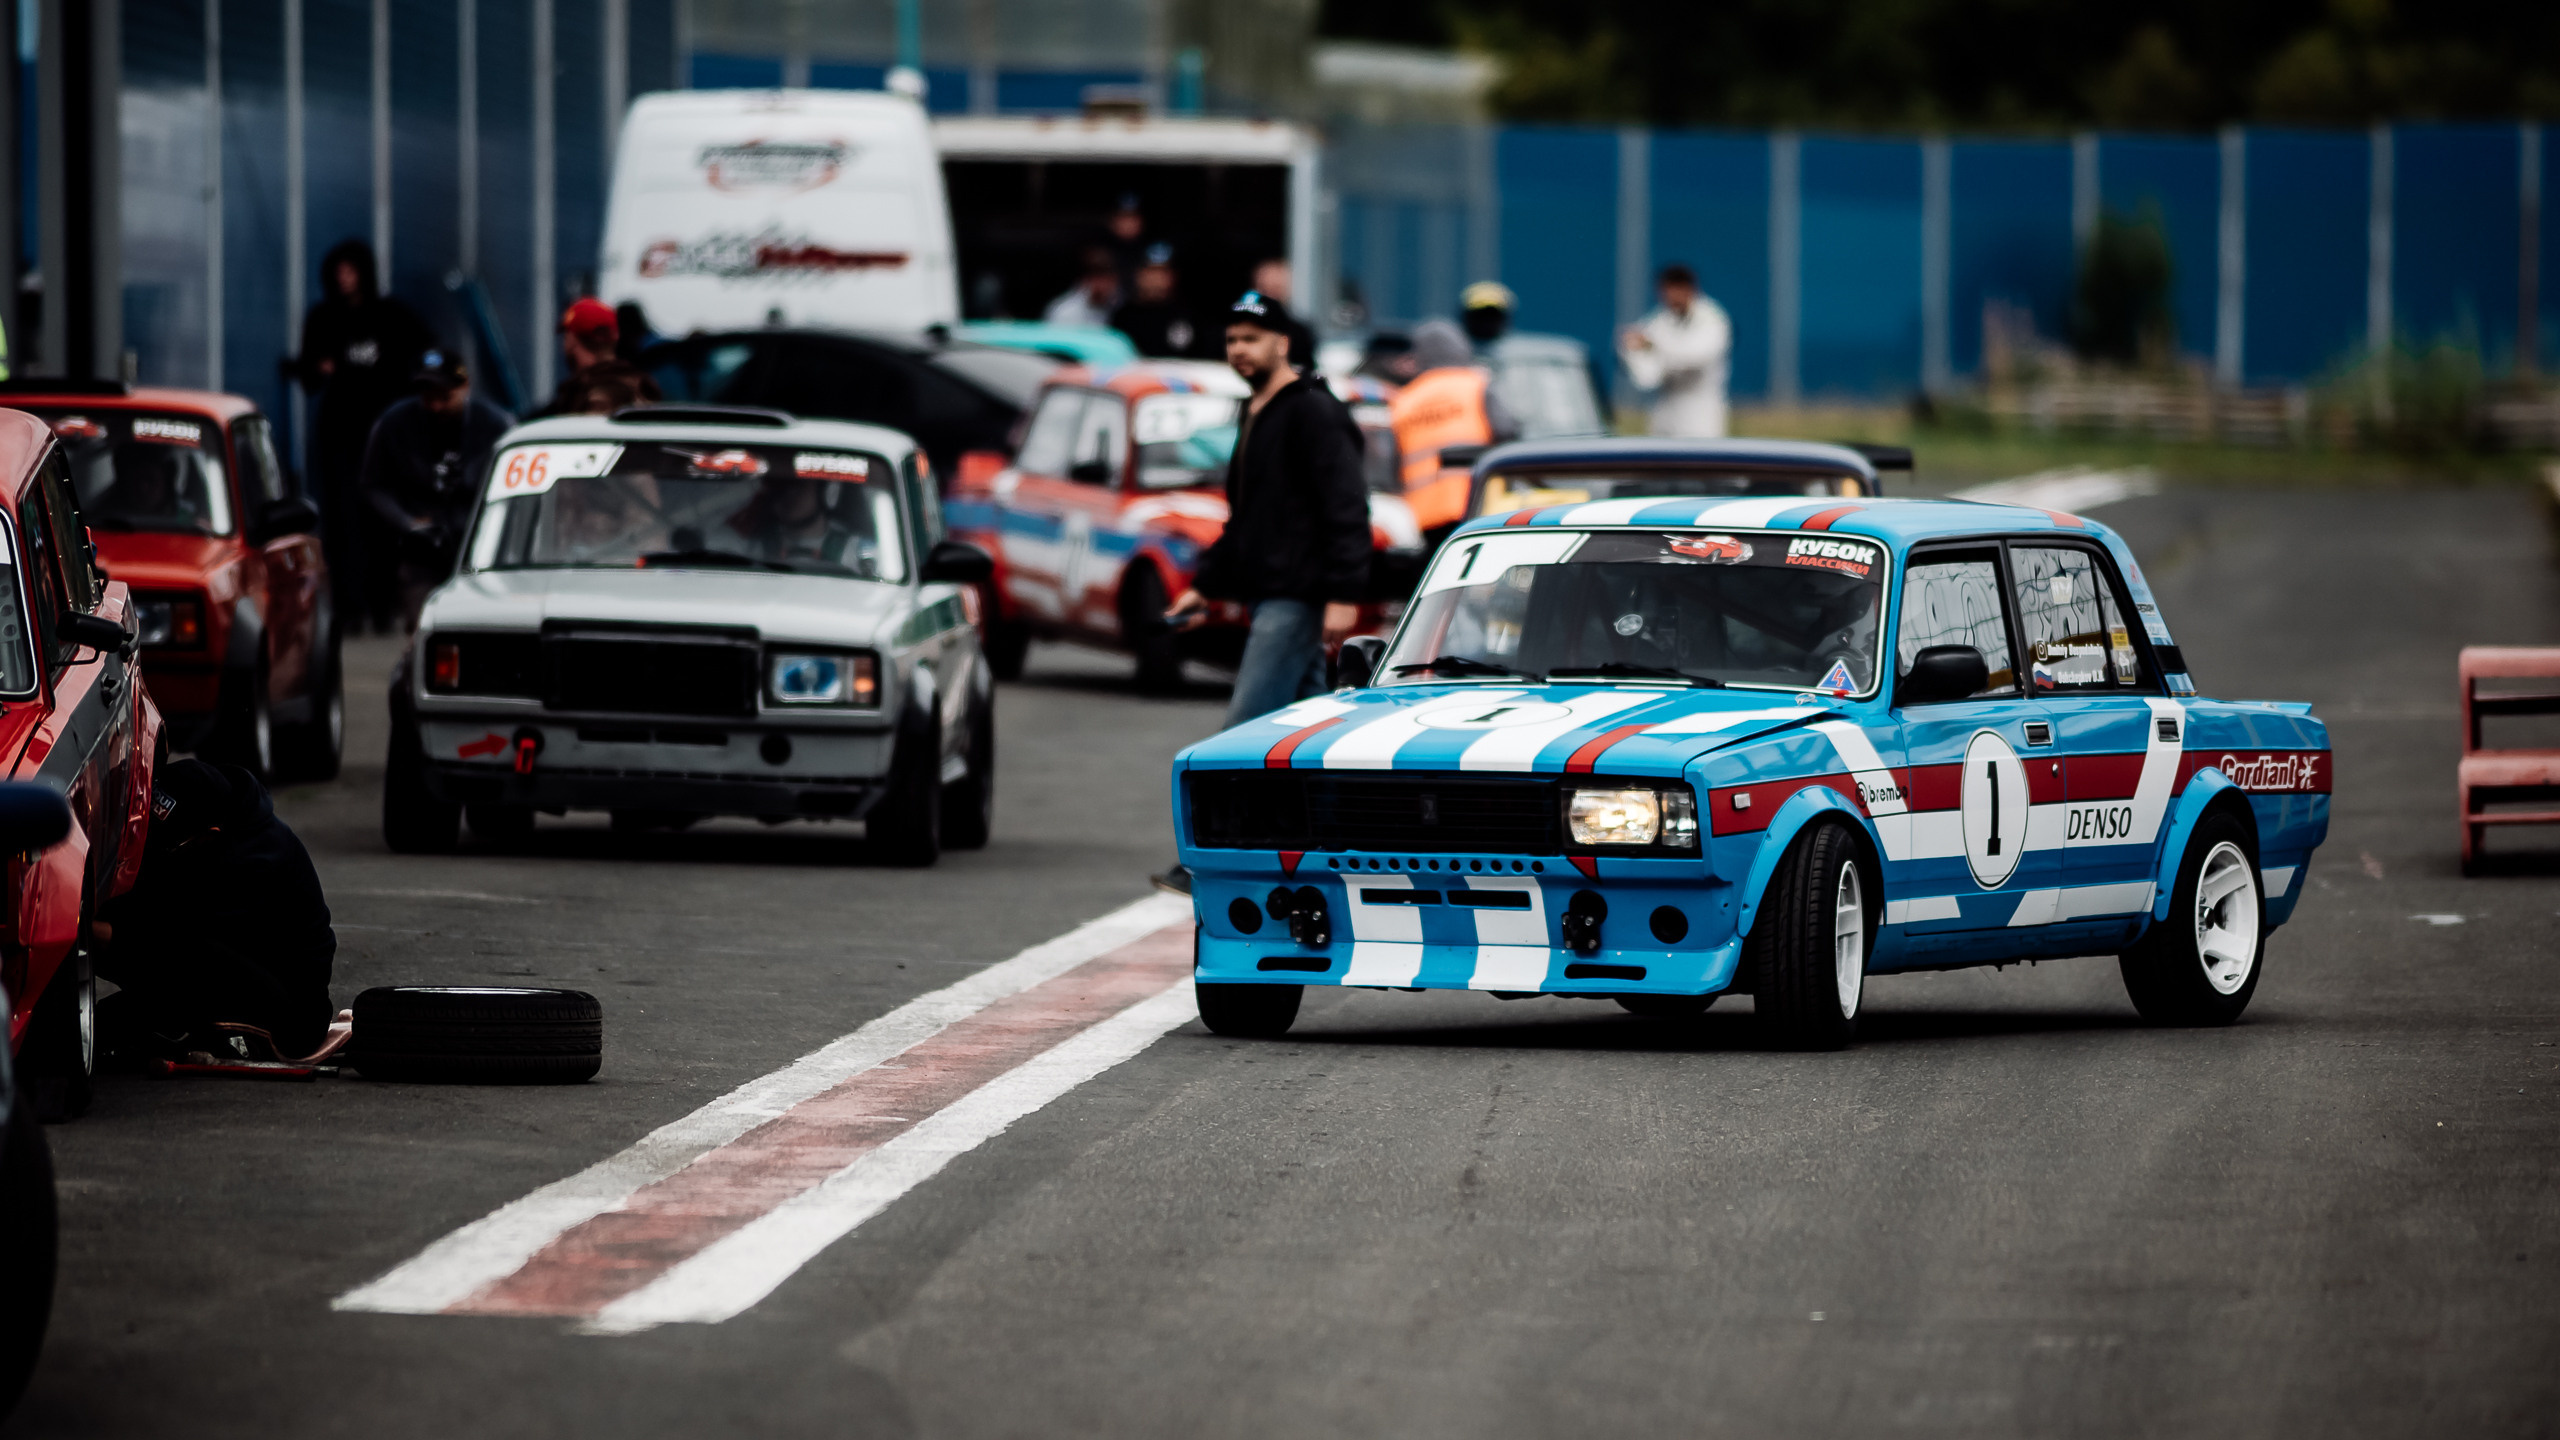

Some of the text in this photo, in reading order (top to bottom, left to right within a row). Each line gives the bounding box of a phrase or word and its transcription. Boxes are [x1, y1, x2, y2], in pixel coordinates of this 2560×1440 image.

[505, 451, 549, 489] 66
[1458, 542, 1485, 581] 1
[1786, 555, 1870, 576] КЛАССИКИ
[1788, 538, 1877, 565] КУБОК
[1462, 707, 1520, 723] 1
[2220, 754, 2298, 790] Cordiant
[1869, 784, 1909, 803] brembo
[1986, 761, 2001, 856] 1
[2067, 807, 2132, 840] DENSO
